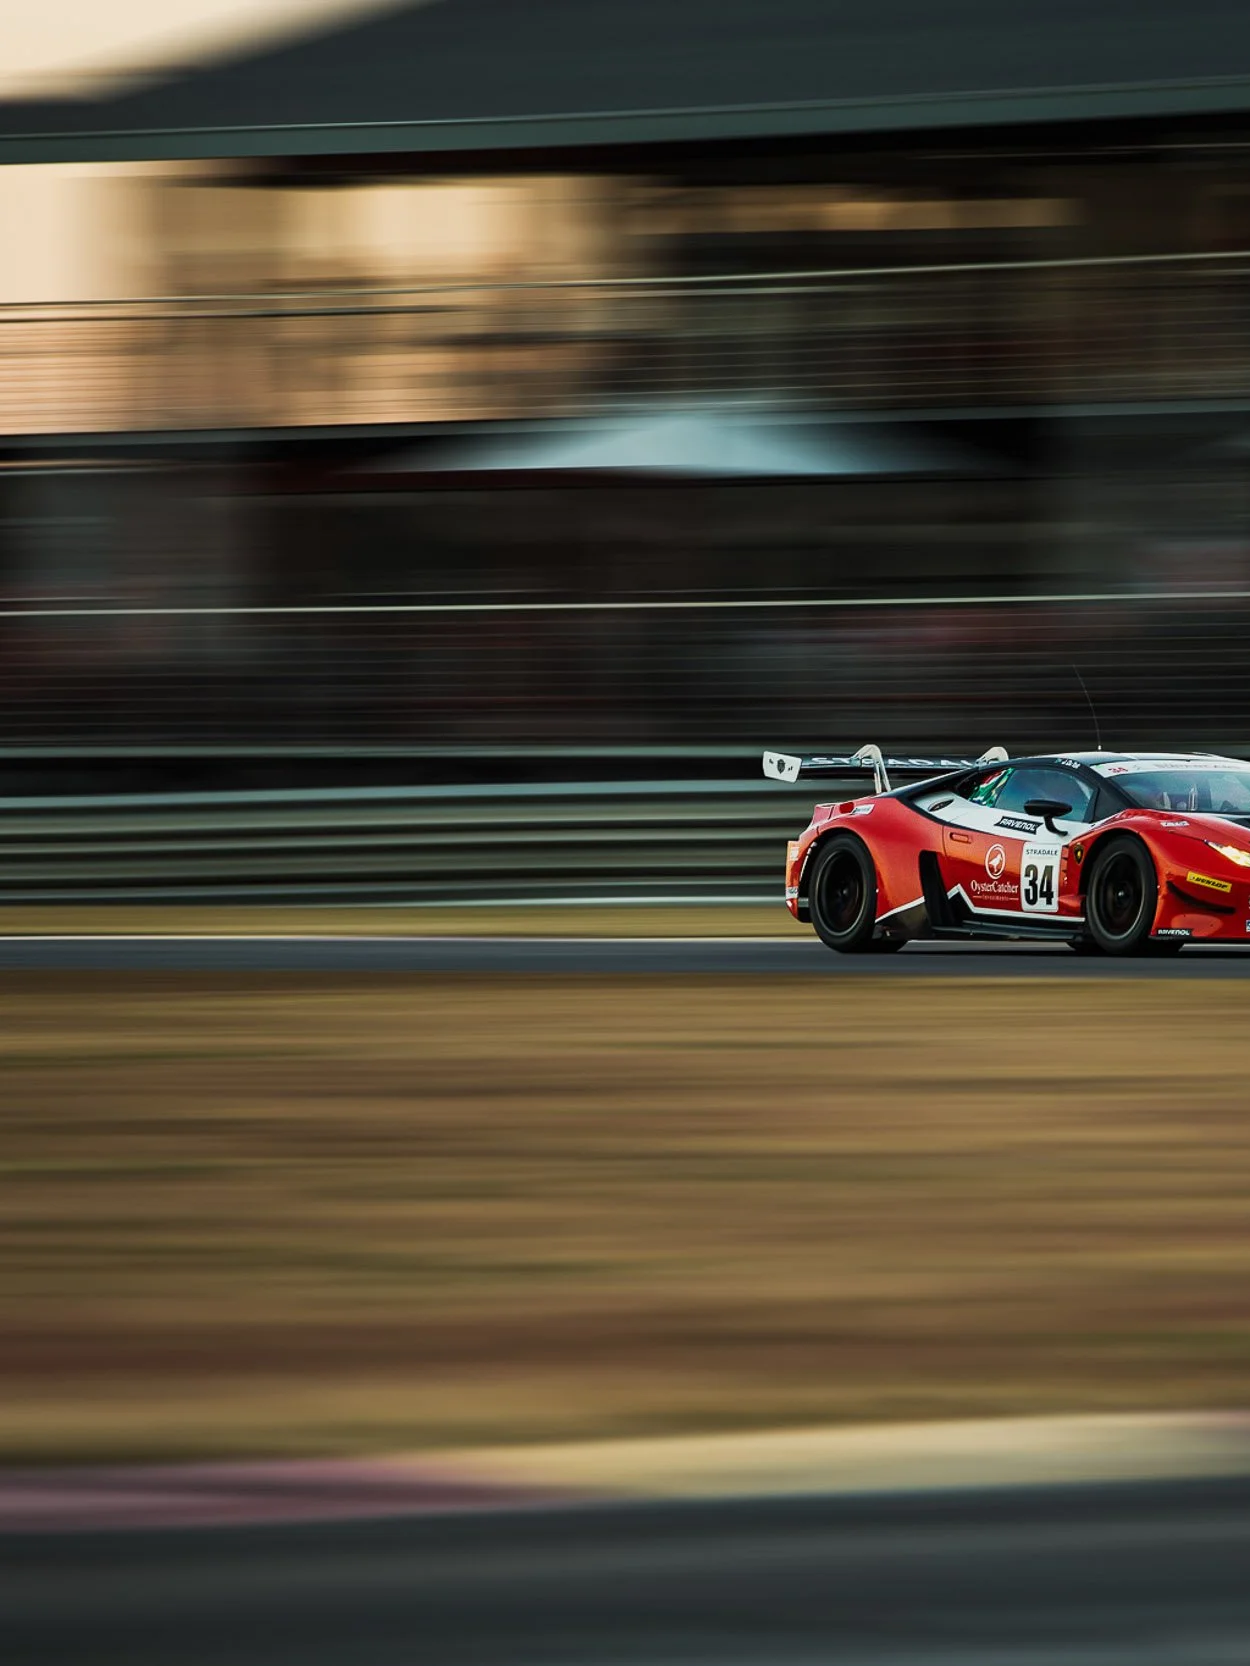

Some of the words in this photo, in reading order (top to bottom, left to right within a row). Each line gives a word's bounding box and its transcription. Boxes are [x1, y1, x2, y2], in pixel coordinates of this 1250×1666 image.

[1000, 818, 1037, 832] RAVENOL
[1026, 848, 1058, 856] STRADALE
[970, 879, 1019, 895] OysterCatcher
[1024, 864, 1054, 906] 34
[1194, 876, 1228, 889] DUNLOP
